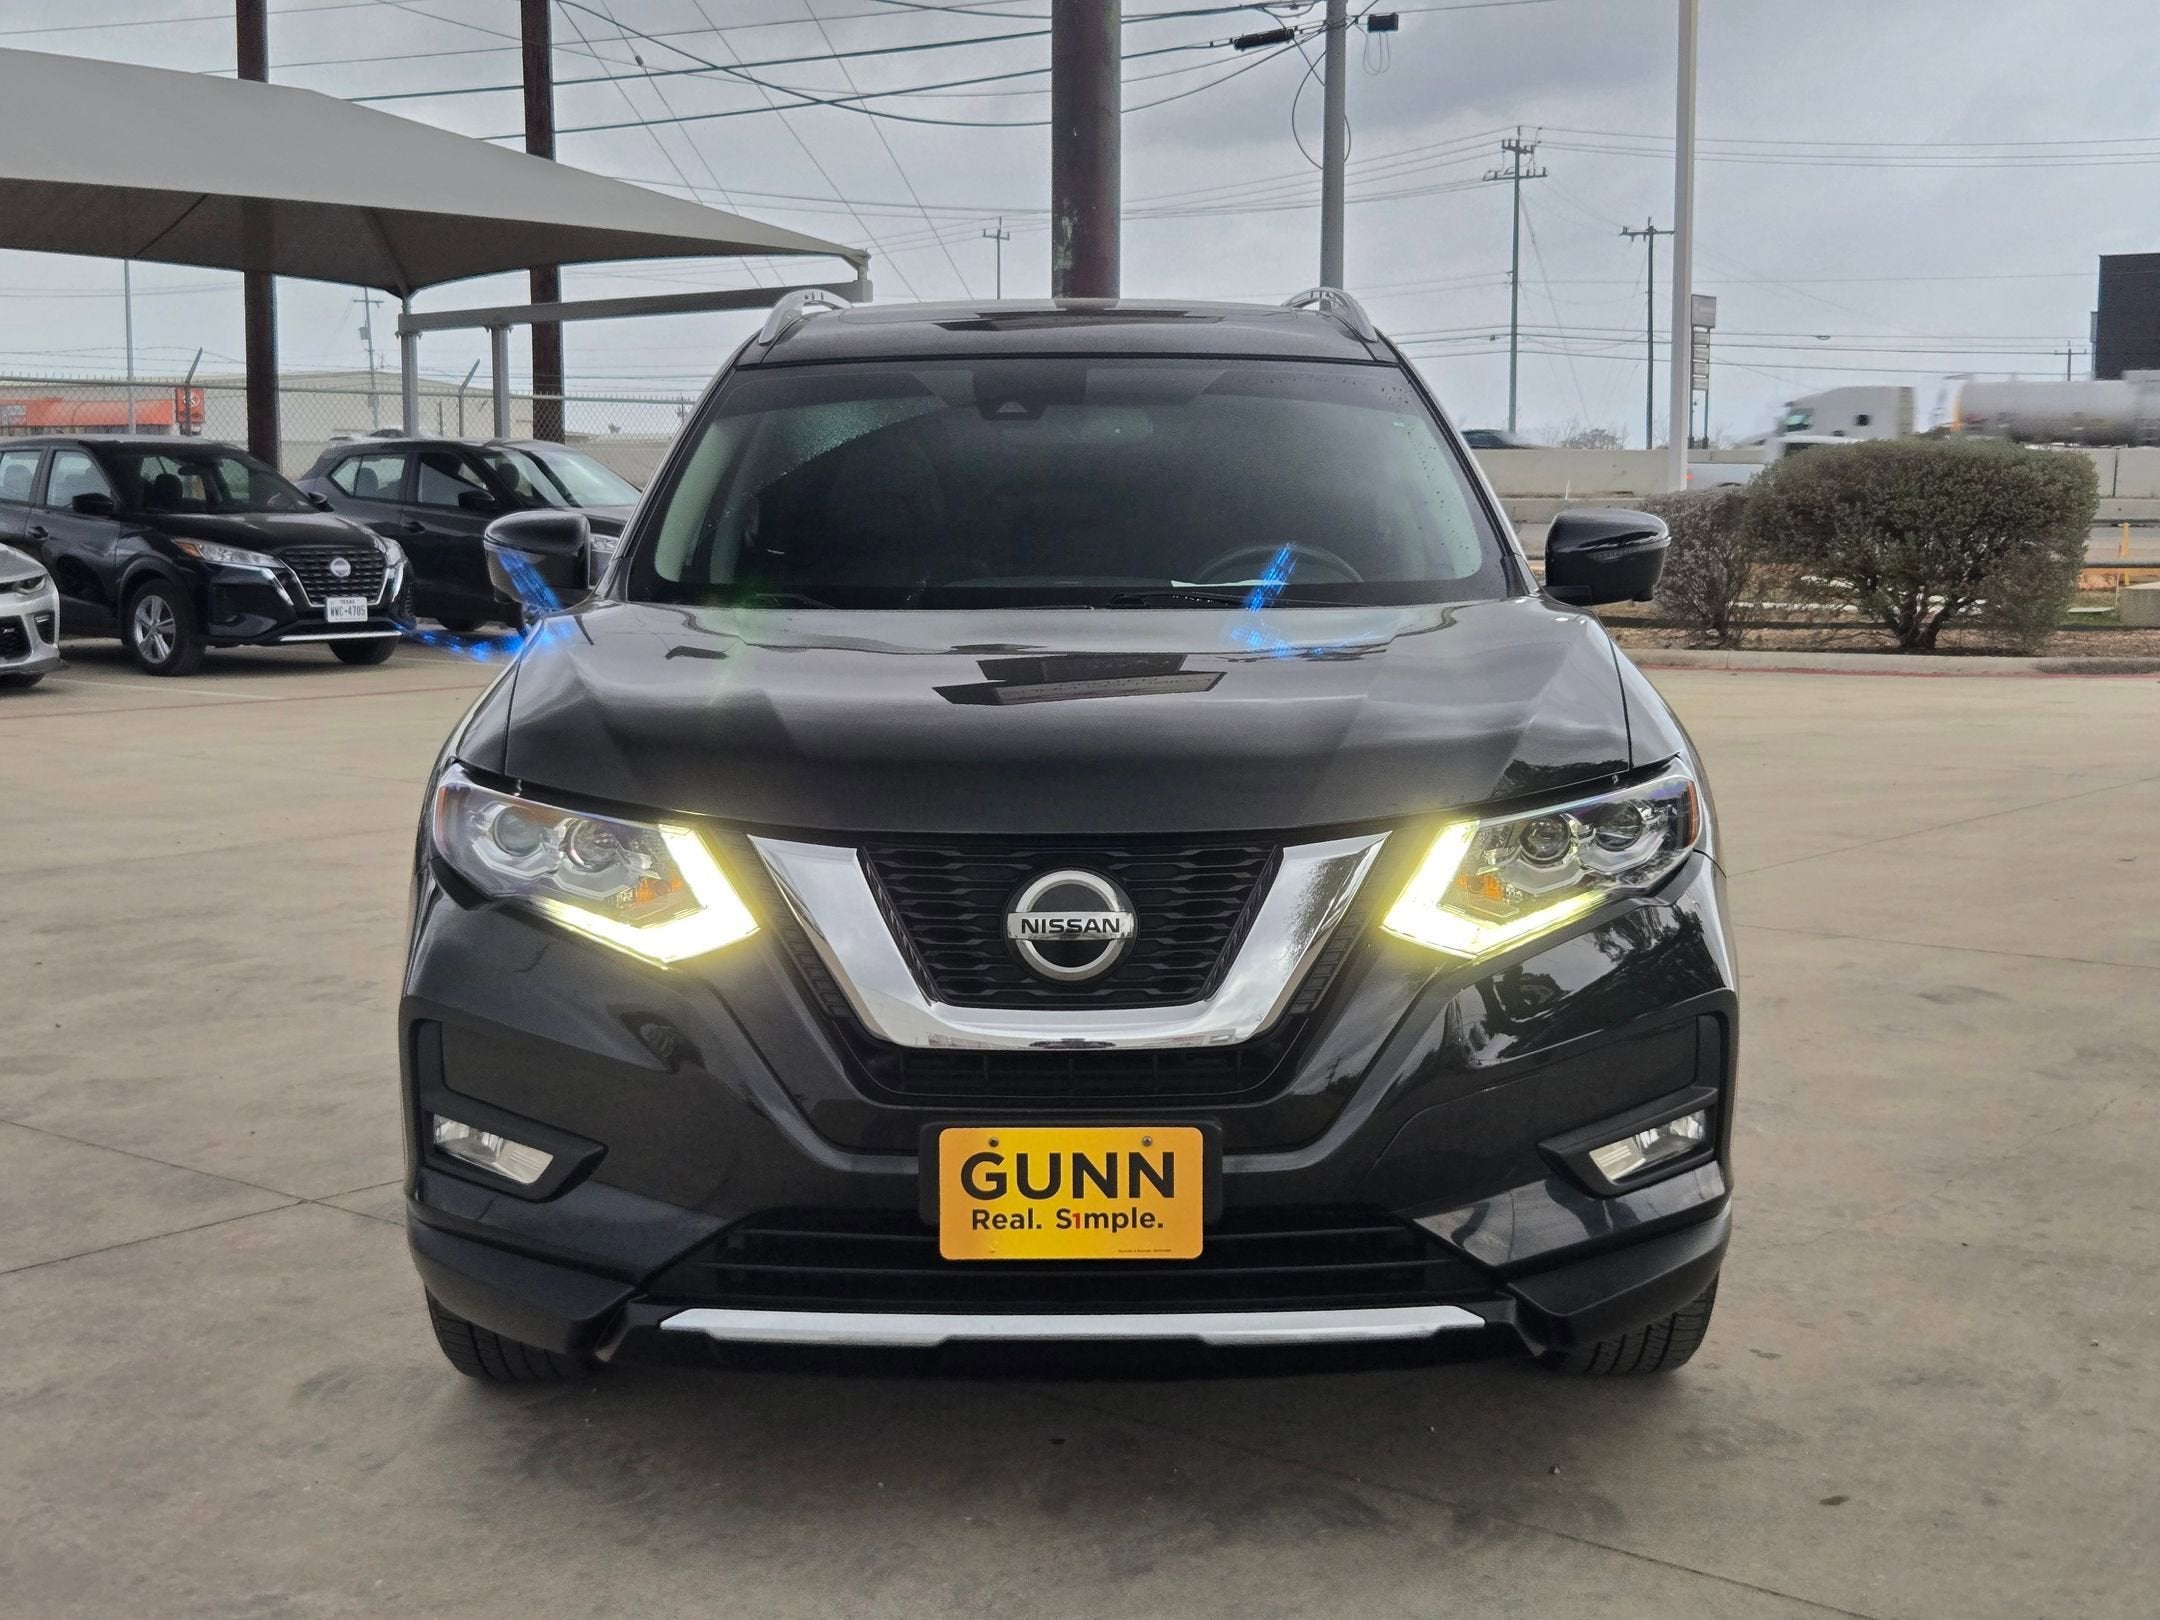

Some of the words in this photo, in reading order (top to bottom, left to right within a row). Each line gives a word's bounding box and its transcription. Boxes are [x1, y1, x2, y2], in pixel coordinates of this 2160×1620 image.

[1021, 918, 1120, 934] NISSAN
[960, 1151, 1175, 1201] GUNN
[972, 1208, 1042, 1231] Real.
